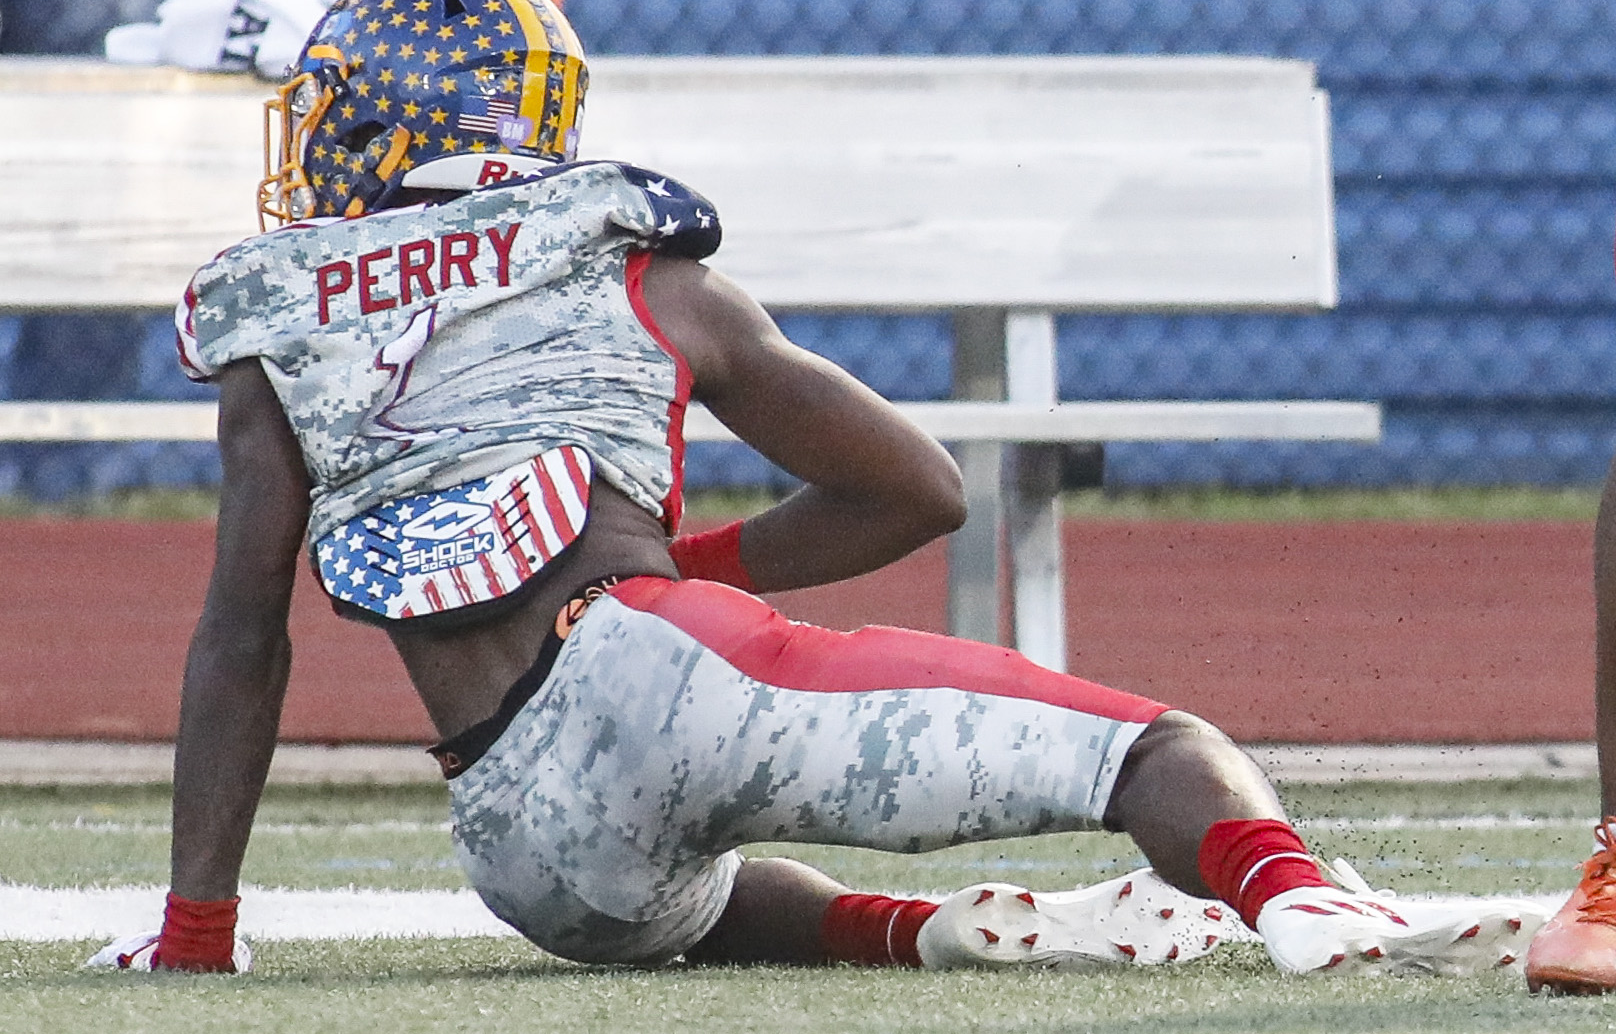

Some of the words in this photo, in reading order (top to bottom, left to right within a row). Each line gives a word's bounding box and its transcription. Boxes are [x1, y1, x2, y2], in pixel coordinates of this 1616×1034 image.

[316, 222, 523, 326] PERRY
[402, 533, 493, 570] SHOCK
[420, 553, 475, 573] DOCTOR
